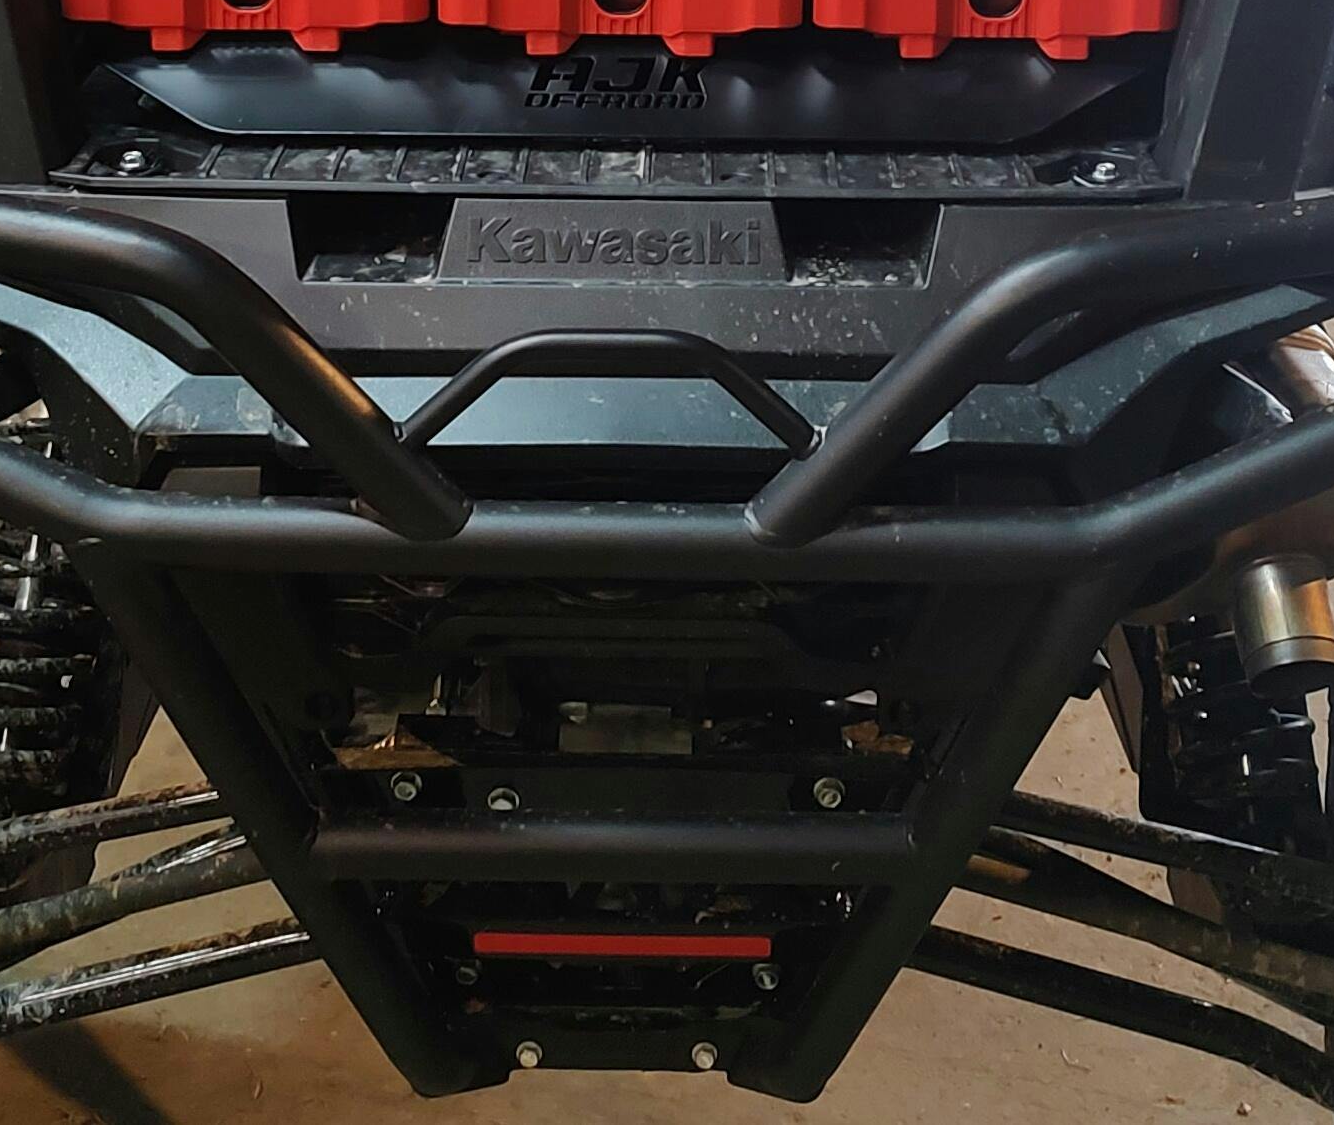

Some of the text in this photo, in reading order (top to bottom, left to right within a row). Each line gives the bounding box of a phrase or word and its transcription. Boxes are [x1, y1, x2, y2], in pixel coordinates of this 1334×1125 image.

[530, 55, 706, 93] AJK
[524, 92, 707, 109] OFFROAD
[466, 217, 762, 265] Kawasaki
